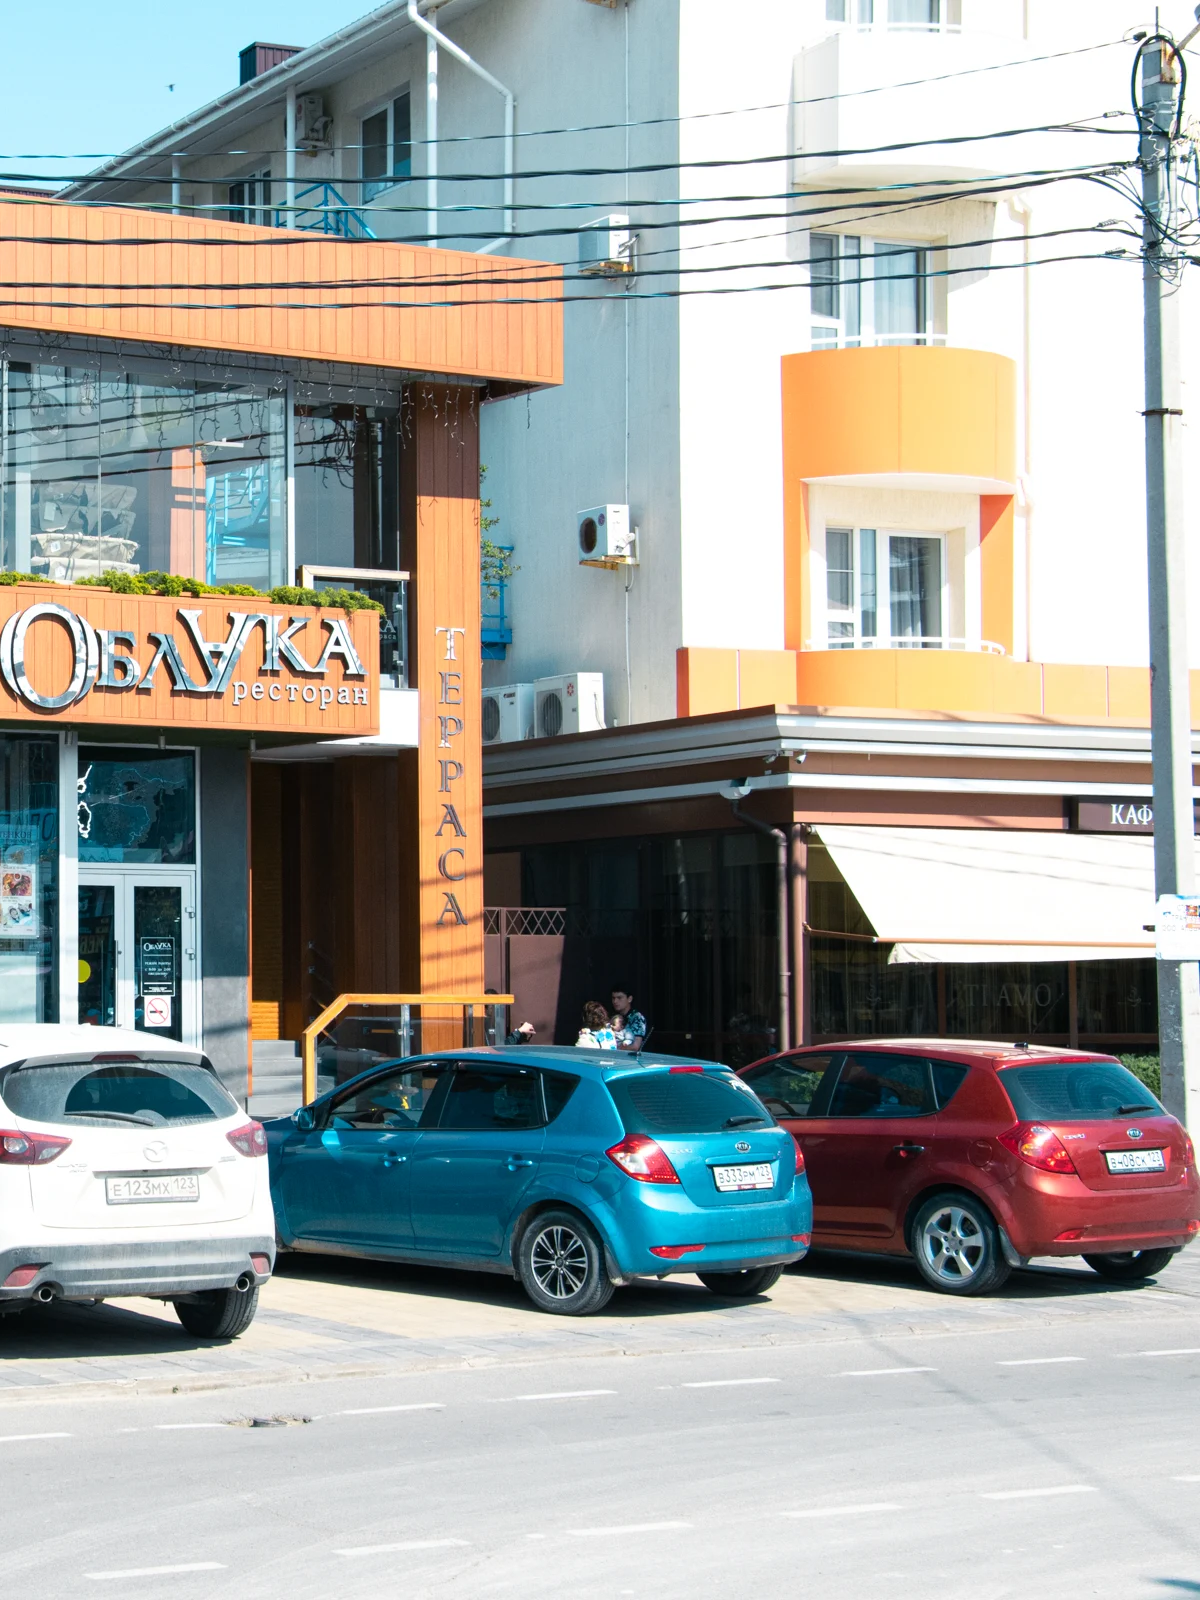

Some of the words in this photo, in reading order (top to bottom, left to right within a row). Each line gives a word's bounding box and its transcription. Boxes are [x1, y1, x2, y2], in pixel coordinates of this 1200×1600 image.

[233, 680, 369, 710] ресторан
[435, 626, 468, 926] ТЕРРАСА
[1110, 804, 1154, 825] КАФ
[996, 983, 1052, 1007] AMO
[173, 1177, 195, 1190] 123
